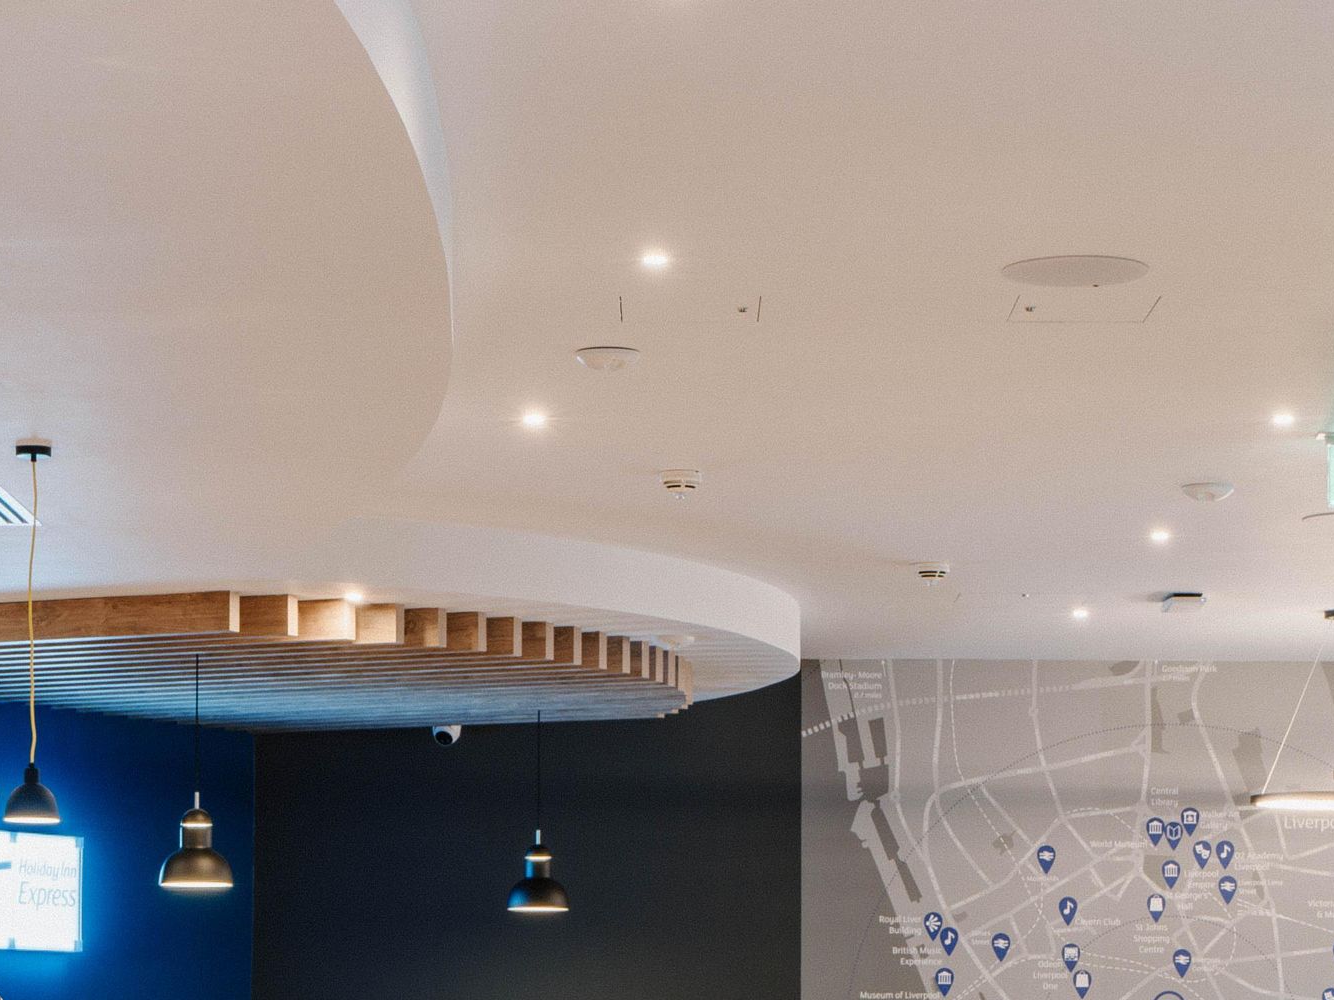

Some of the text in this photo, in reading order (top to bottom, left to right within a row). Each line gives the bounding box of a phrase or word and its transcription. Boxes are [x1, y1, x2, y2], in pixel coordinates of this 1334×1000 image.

[849, 682, 882, 690] Stadium
[1151, 787, 1179, 795] Central
[1151, 798, 1179, 808] Library
[1200, 822, 1228, 831] Gallery
[1090, 840, 1147, 848] World Museum
[19, 859, 77, 880] Holiday Inn
[18, 881, 76, 910] Express
[879, 916, 921, 925] Royal Liver
[1103, 918, 1121, 926] Club
[889, 927, 921, 936] Building
[1133, 935, 1170, 945] Shopping
[892, 947, 942, 955] British Music
[1139, 946, 1164, 955] Centre
[900, 958, 942, 967] Experience
[1038, 960, 1063, 969] Odeon
[1033, 971, 1068, 981] Liverpool
[1042, 982, 1058, 990] One
[895, 991, 903, 999] of
[905, 991, 941, 1000] Liverpool
